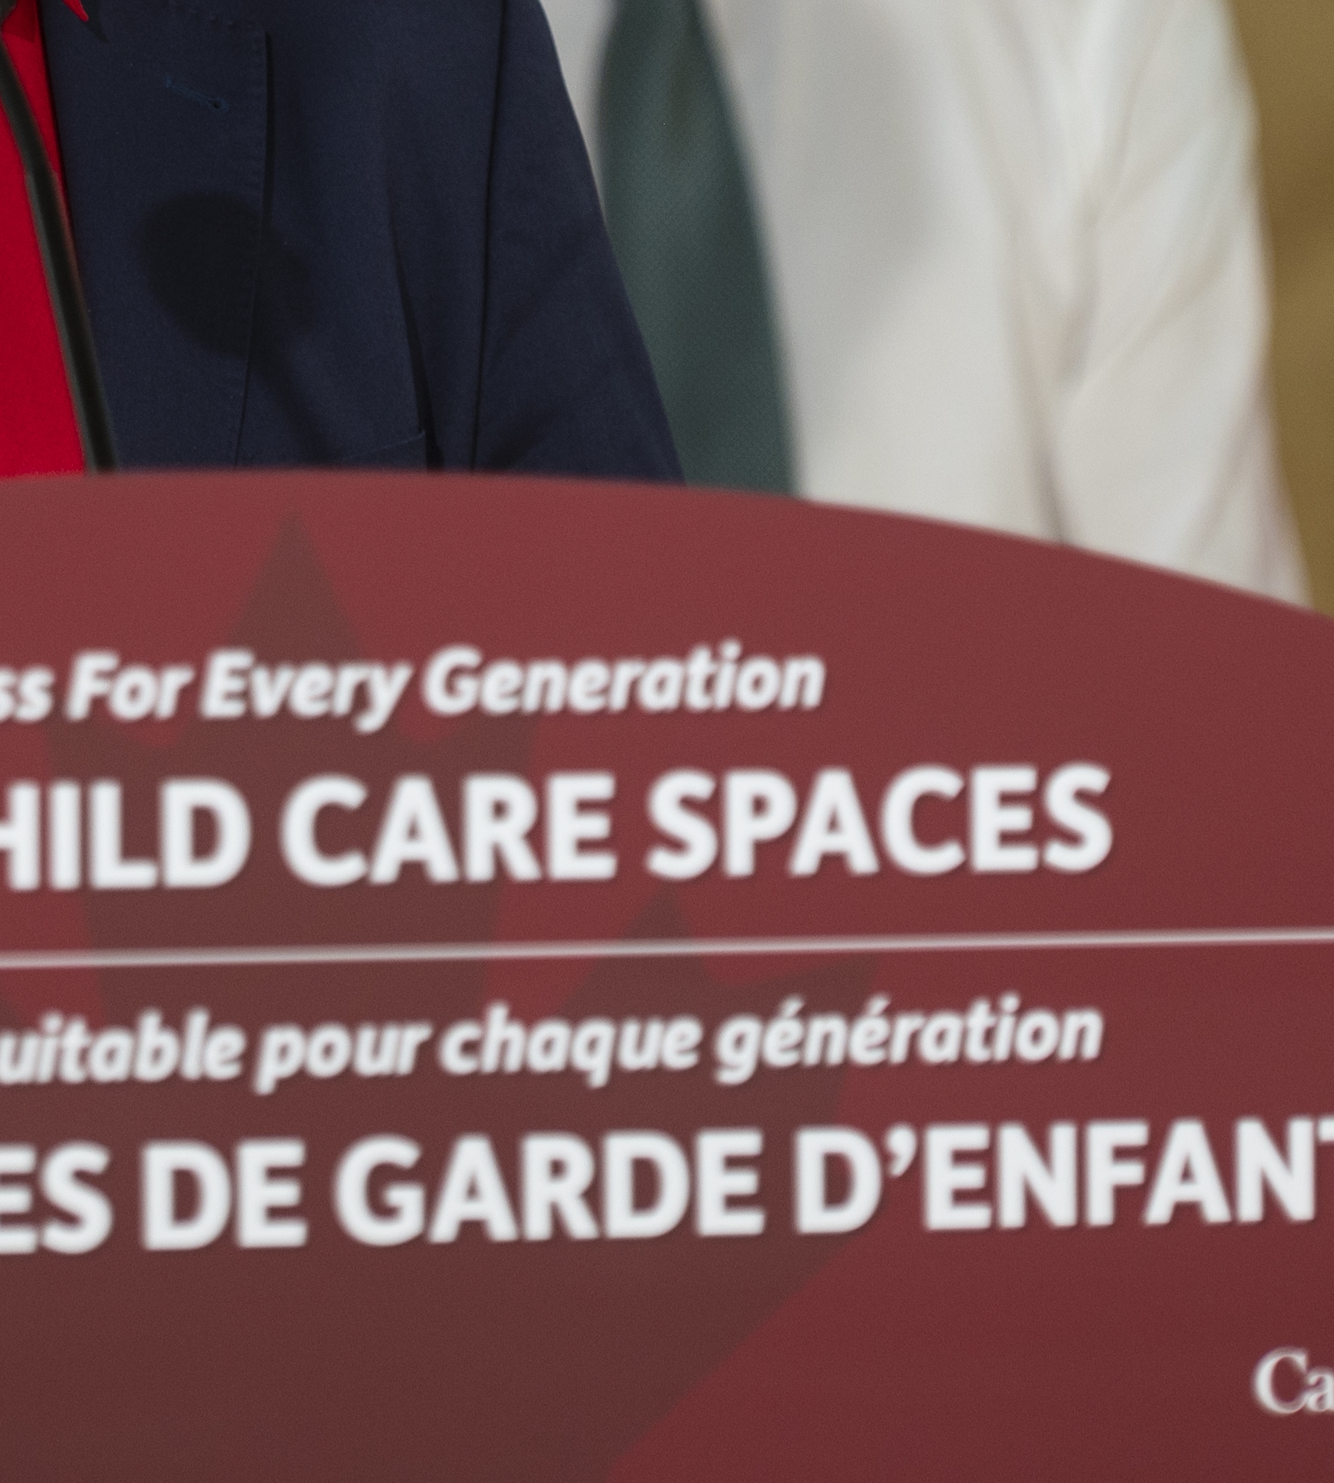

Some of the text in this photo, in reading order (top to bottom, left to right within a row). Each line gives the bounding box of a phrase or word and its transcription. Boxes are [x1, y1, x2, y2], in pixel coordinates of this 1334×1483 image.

[65, 651, 194, 720] For
[200, 649, 413, 733] Every
[422, 639, 825, 715] Generation
[280, 771, 617, 886] CARE
[646, 763, 1112, 880] SPACES
[254, 1023, 432, 1094] pour
[438, 1002, 703, 1088] chaque
[714, 993, 1103, 1085] génération
[141, 1139, 307, 1250] DE
[334, 1128, 765, 1246] GARDE
